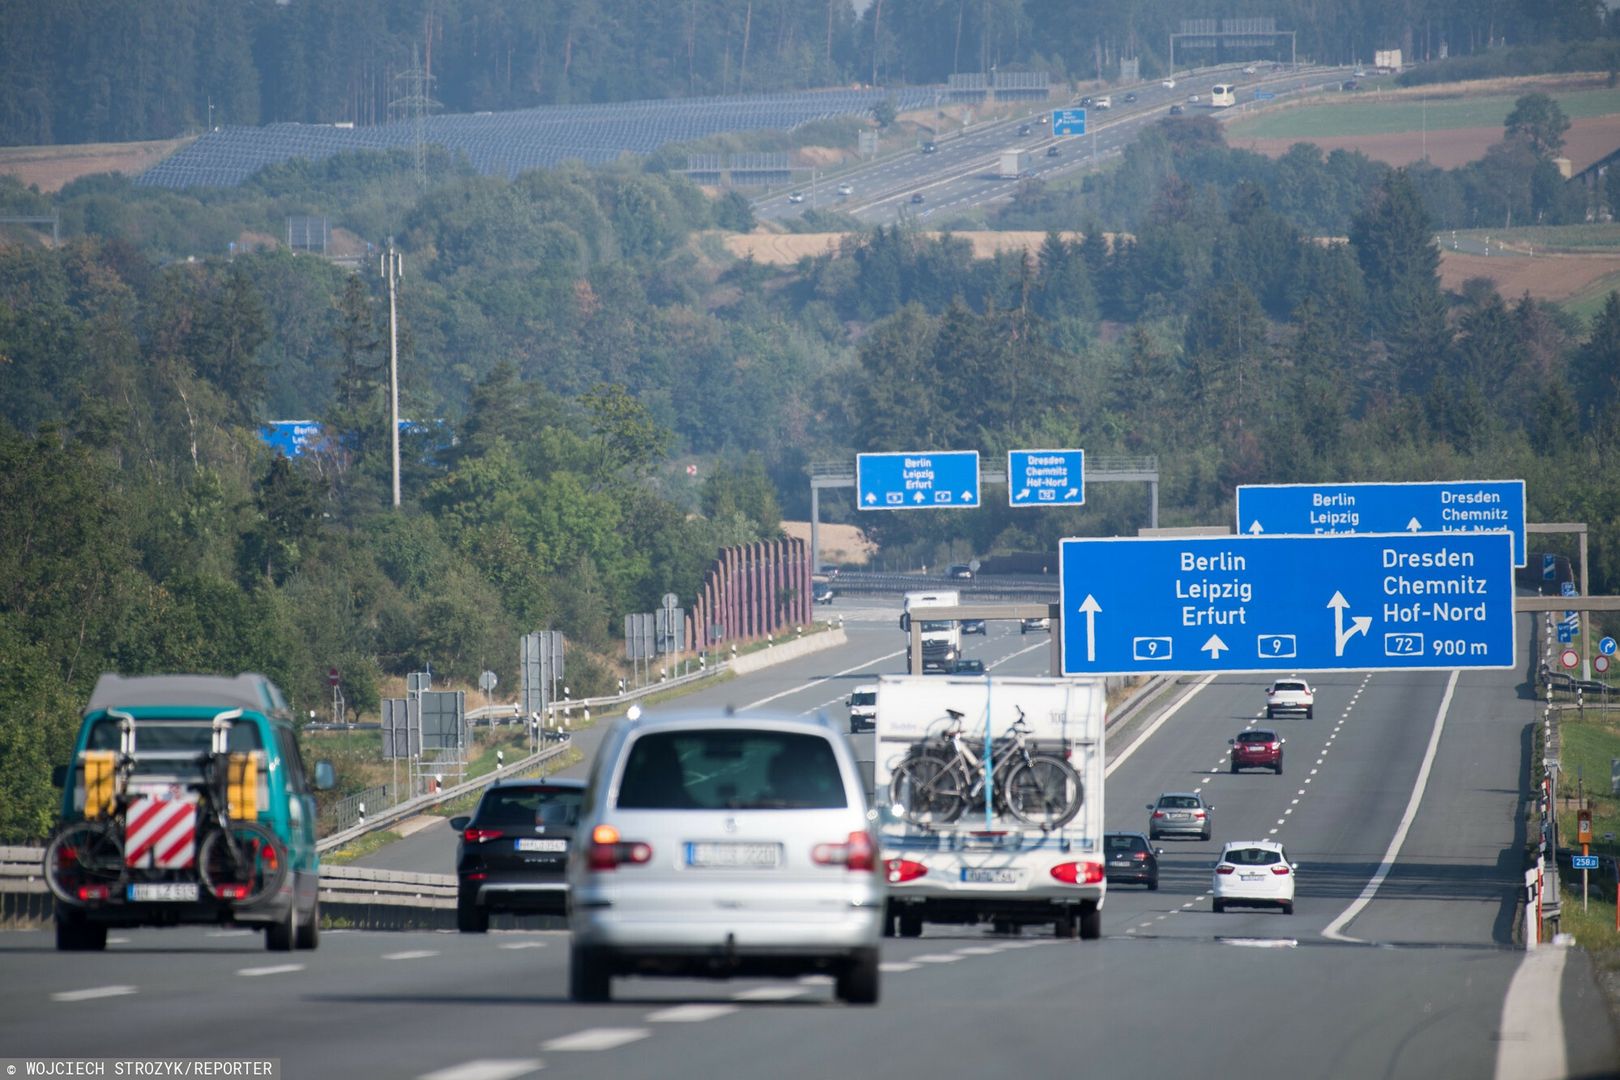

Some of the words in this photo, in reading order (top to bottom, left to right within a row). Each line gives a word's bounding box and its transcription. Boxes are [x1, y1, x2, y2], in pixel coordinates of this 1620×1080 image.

[904, 458, 932, 468] Berlin
[1027, 455, 1065, 466] Dresden
[902, 469, 935, 480] Leipzig
[1025, 466, 1068, 477] Chemnitz
[905, 480, 932, 490] Erfurt
[1026, 477, 1068, 487] Hof-Nord
[1312, 493, 1356, 507] Berlin
[1441, 490, 1501, 504] Dresden
[1310, 510, 1360, 526] Leipzig
[1442, 508, 1509, 521] Chemnitz
[1180, 551, 1247, 572] Berlin
[1382, 548, 1475, 568] Dresden
[1175, 578, 1253, 603] Leipzig
[1383, 575, 1488, 596] Chemnitz
[1182, 606, 1247, 626] Erfurt
[1383, 602, 1487, 623] Hof-Nord
[1148, 641, 1158, 656] 9
[1272, 639, 1282, 654] 9
[1395, 637, 1414, 652] 72
[1432, 639, 1466, 656] 900
[1470, 642, 1488, 655] m
